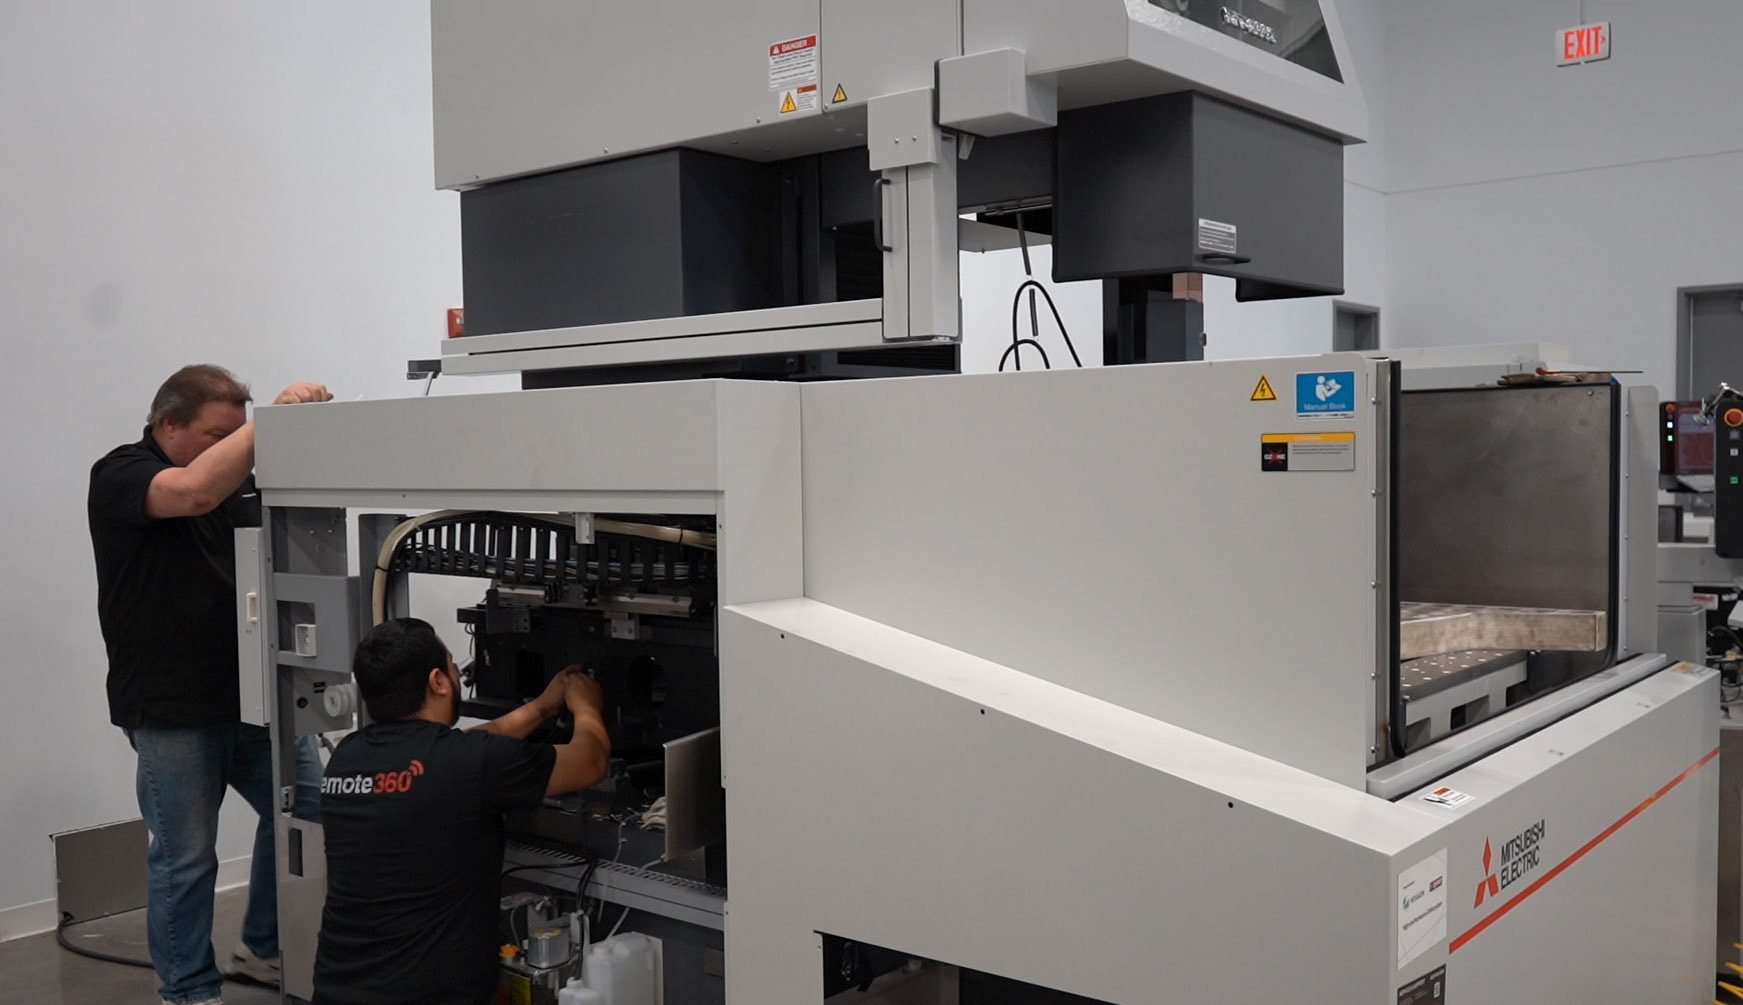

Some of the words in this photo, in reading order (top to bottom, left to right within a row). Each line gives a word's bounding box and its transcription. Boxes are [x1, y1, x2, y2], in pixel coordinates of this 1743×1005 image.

[1564, 25, 1603, 60] EXIT
[1303, 402, 1328, 411] Manual
[1328, 402, 1347, 410] Book
[1500, 818, 1546, 867] MITSUBISHI
[1500, 845, 1541, 891] ELECTRIC
